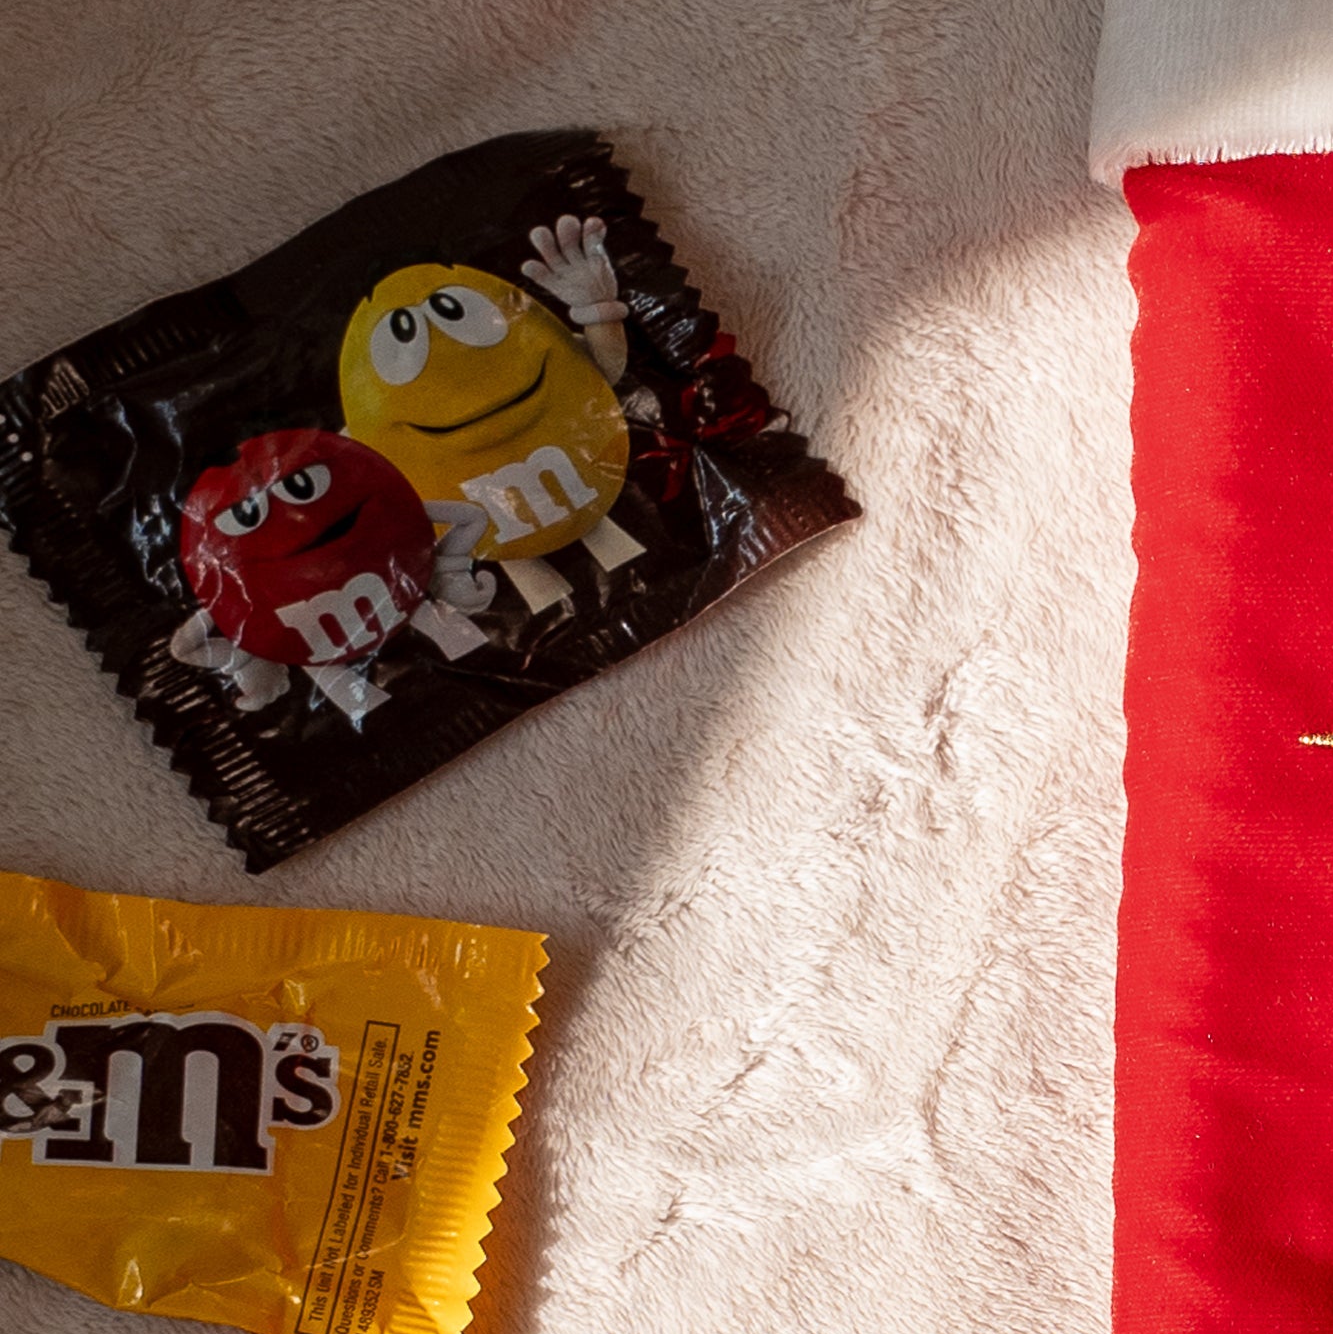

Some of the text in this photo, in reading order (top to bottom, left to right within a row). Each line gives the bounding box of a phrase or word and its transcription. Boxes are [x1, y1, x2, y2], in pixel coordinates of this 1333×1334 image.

[459, 445, 599, 545] m
[274, 572, 408, 664] m
[51, 999, 131, 1018] CHOCOLATE
[360, 1071, 380, 1108] Retail
[391, 1030, 441, 1182] Visit mms.com
[349, 1110, 372, 1170] Individual
[342, 1171, 359, 1191] for
[373, 1157, 390, 1185] Call
[329, 1193, 355, 1244] Labeled
[355, 1187, 386, 1261] Comments?
[322, 1246, 341, 1269] Not
[352, 1264, 366, 1278] or
[316, 1271, 334, 1293] Unit
[308, 1295, 328, 1322] This
